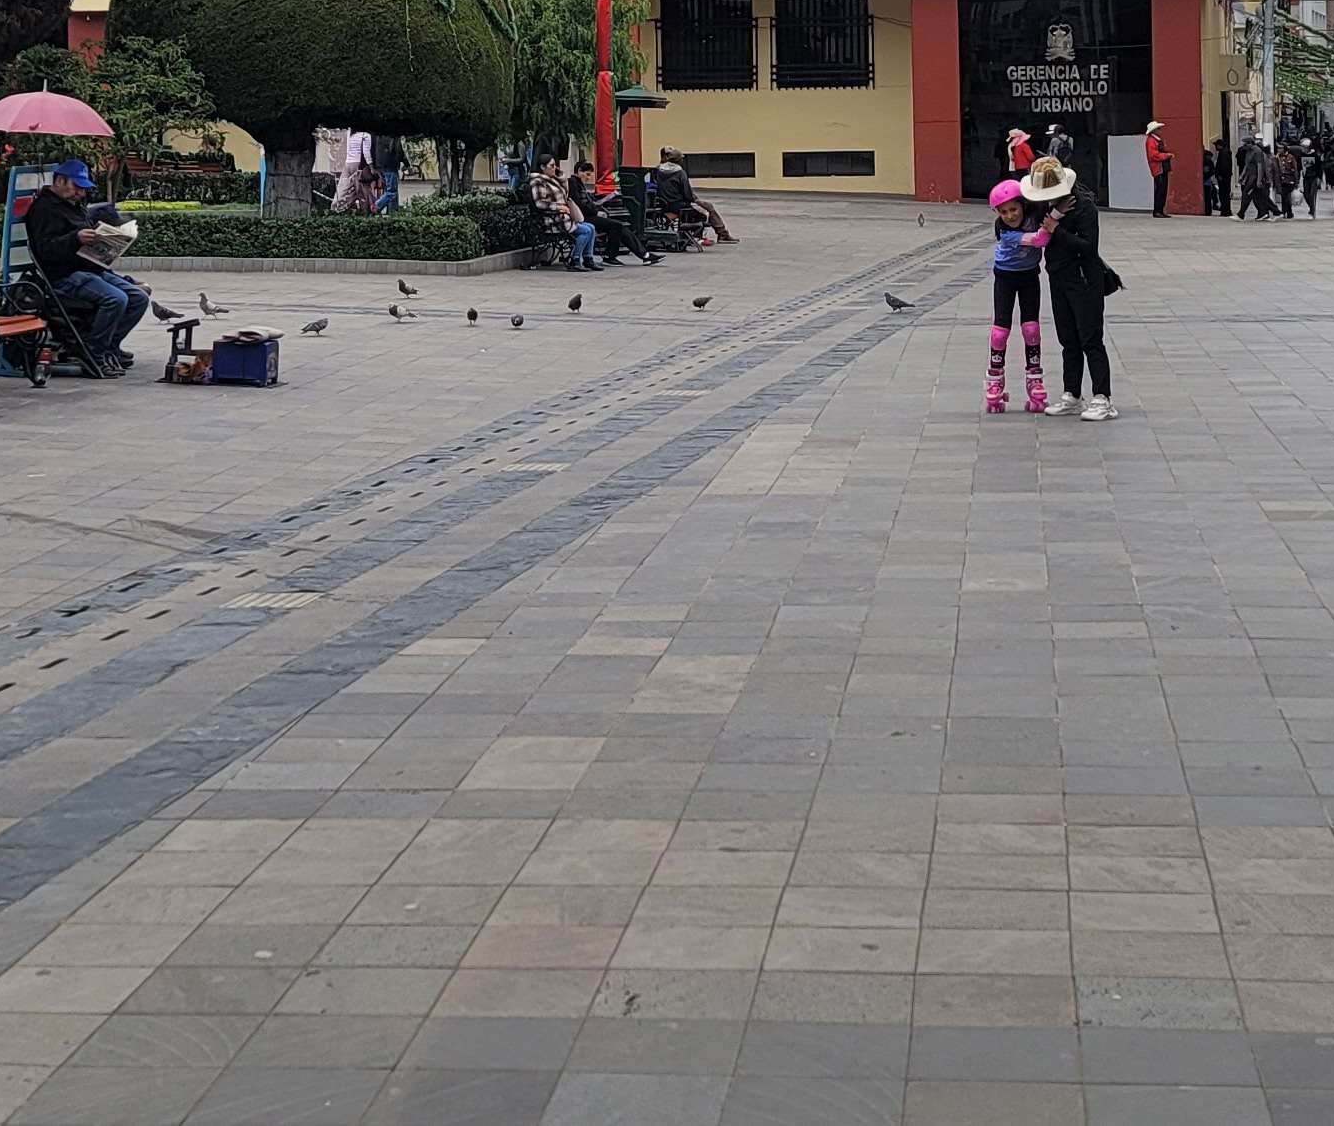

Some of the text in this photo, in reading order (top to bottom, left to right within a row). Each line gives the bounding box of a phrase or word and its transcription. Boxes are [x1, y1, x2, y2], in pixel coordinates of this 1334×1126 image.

[1007, 64, 1109, 80] GERENCIA DE
[1012, 80, 1107, 96] DESARROLLO
[1031, 97, 1093, 112] URBANO
